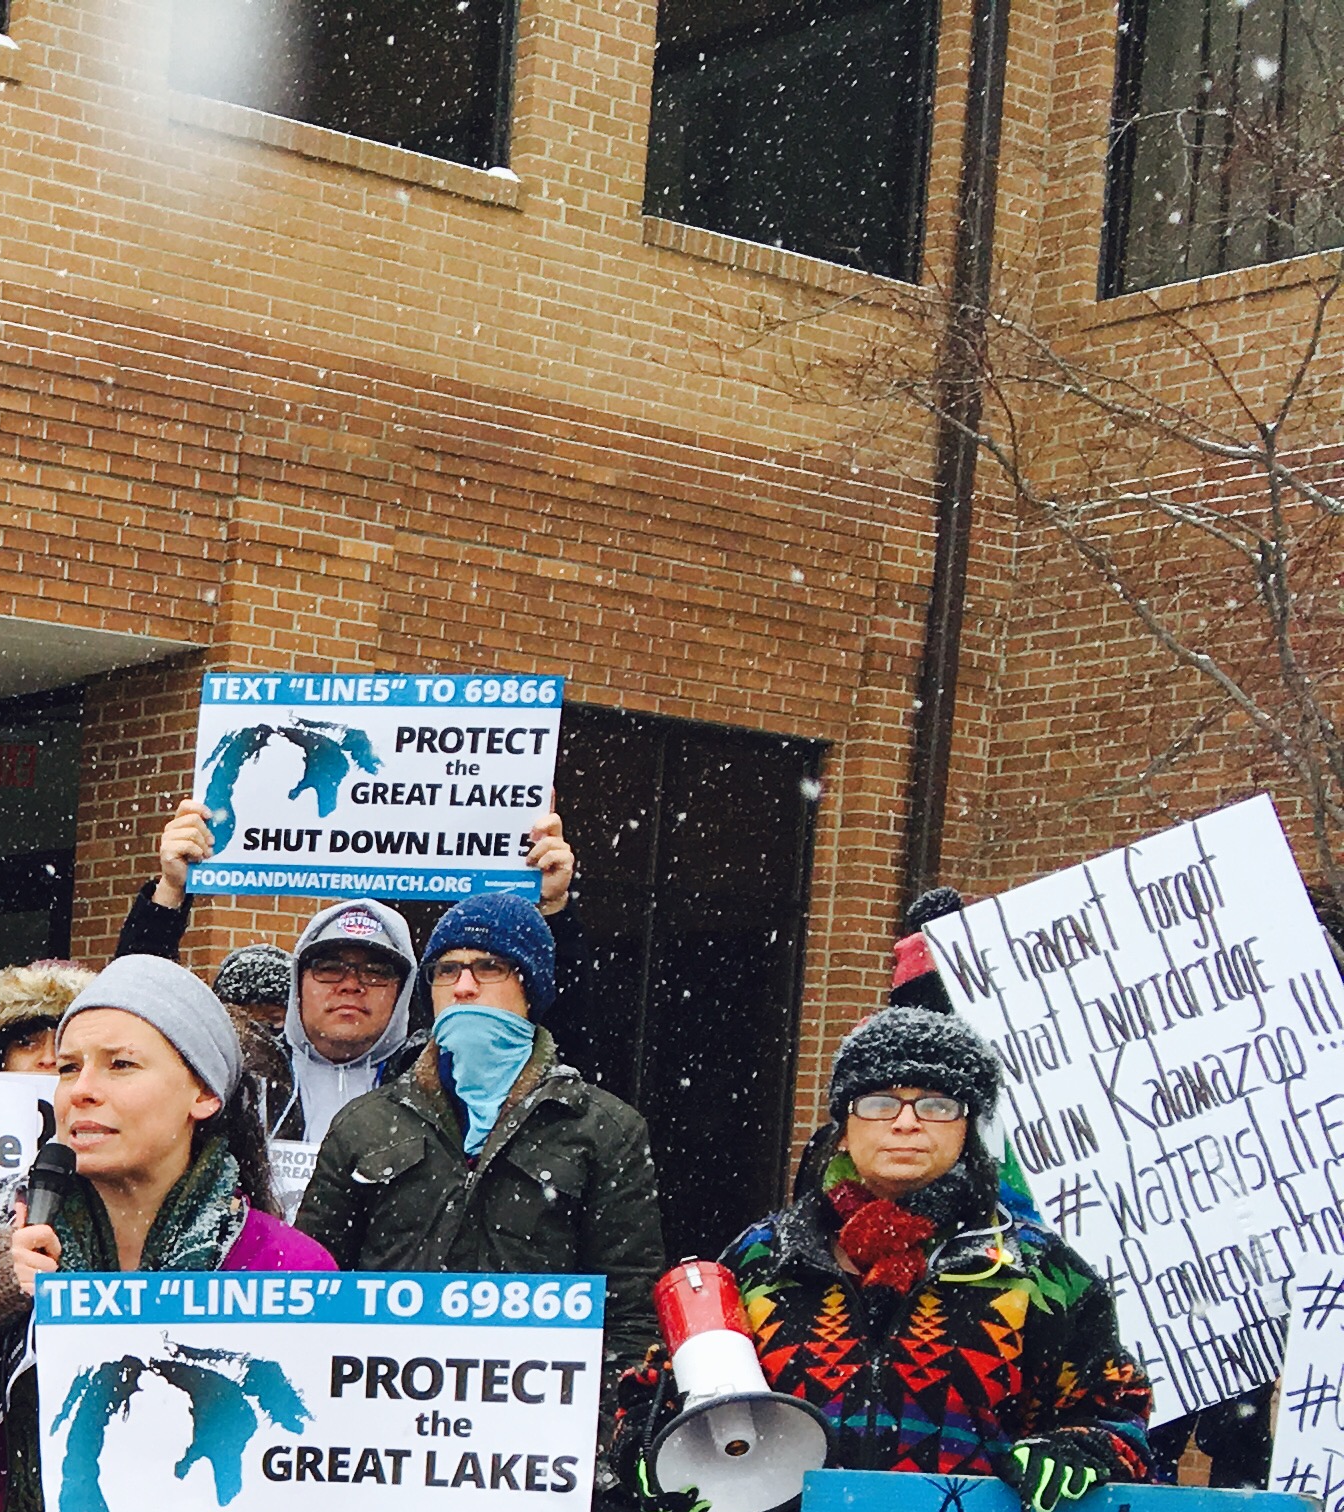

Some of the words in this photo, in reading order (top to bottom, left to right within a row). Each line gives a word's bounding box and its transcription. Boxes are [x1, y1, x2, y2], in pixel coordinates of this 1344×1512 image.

[208, 676, 281, 701] TEXT
[415, 679, 458, 703] TO
[464, 679, 556, 705] 69866
[395, 726, 550, 756] PROTECT
[445, 759, 480, 777] the
[350, 781, 443, 806] GREAT
[449, 783, 543, 809] LAKES
[243, 827, 323, 852] SHUT
[329, 829, 430, 855] DOWN
[436, 831, 510, 857] LINE
[191, 870, 472, 893] FOODANDWATERWATCH.ORG
[337, 916, 384, 932] PISTONS
[271, 1150, 318, 1166] PROT
[272, 1165, 315, 1180] GREA
[43, 1280, 147, 1316] TEXT
[357, 1280, 423, 1316] TO
[440, 1281, 592, 1320] 69866
[330, 1356, 586, 1405] PROTECT
[415, 1410, 472, 1437] the
[262, 1445, 411, 1485] GREAT
[424, 1451, 578, 1494] LAKES
